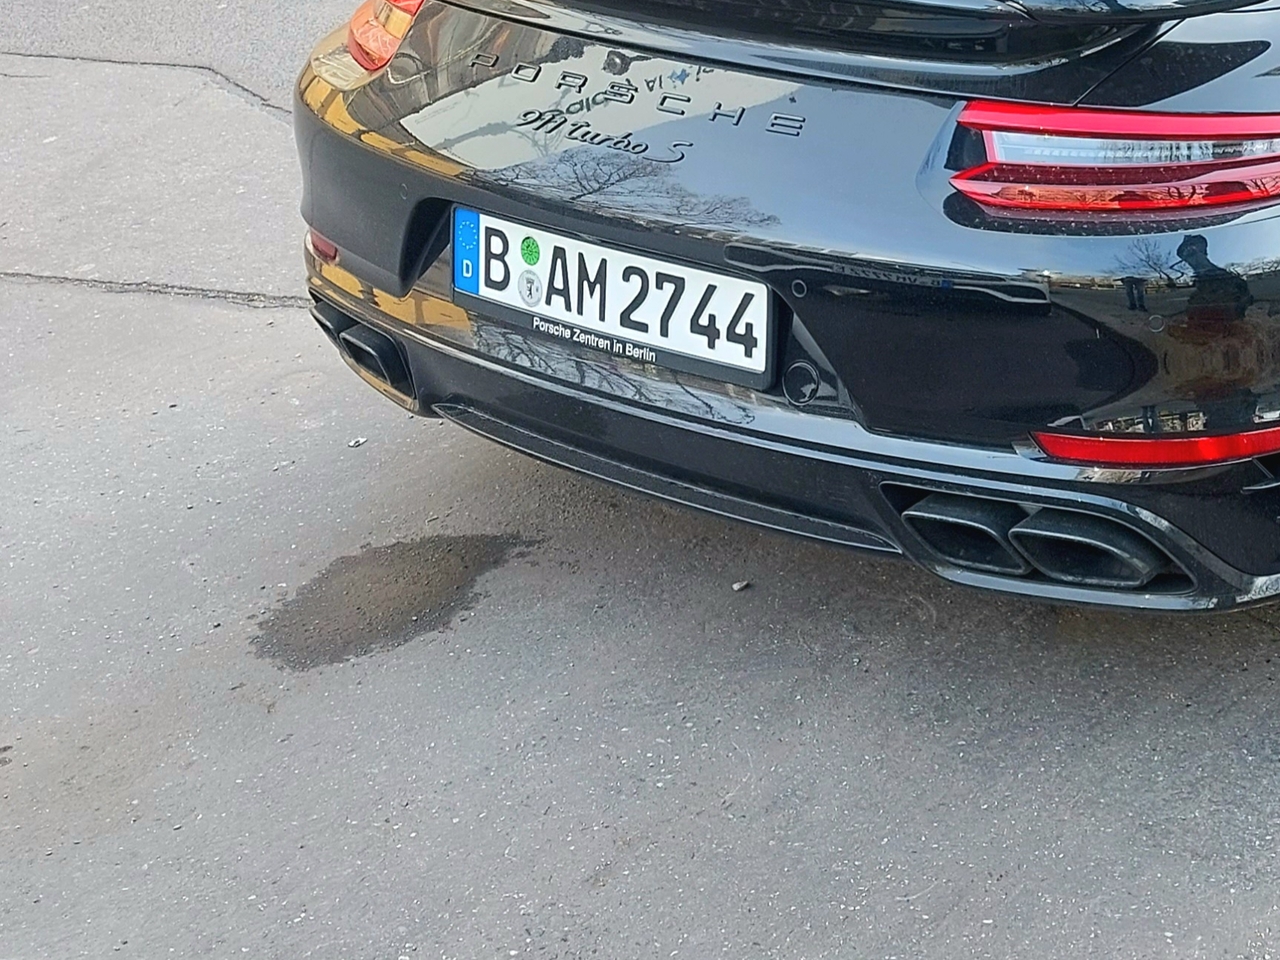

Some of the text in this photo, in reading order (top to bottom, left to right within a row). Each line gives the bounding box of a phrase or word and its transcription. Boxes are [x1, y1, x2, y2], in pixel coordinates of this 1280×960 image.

[468, 53, 806, 138] PORSCHE
[516, 109, 694, 164] 911 turbo S
[462, 225, 758, 358] D B AM 2744
[532, 316, 656, 363] Porsche Zentren in Berlin
